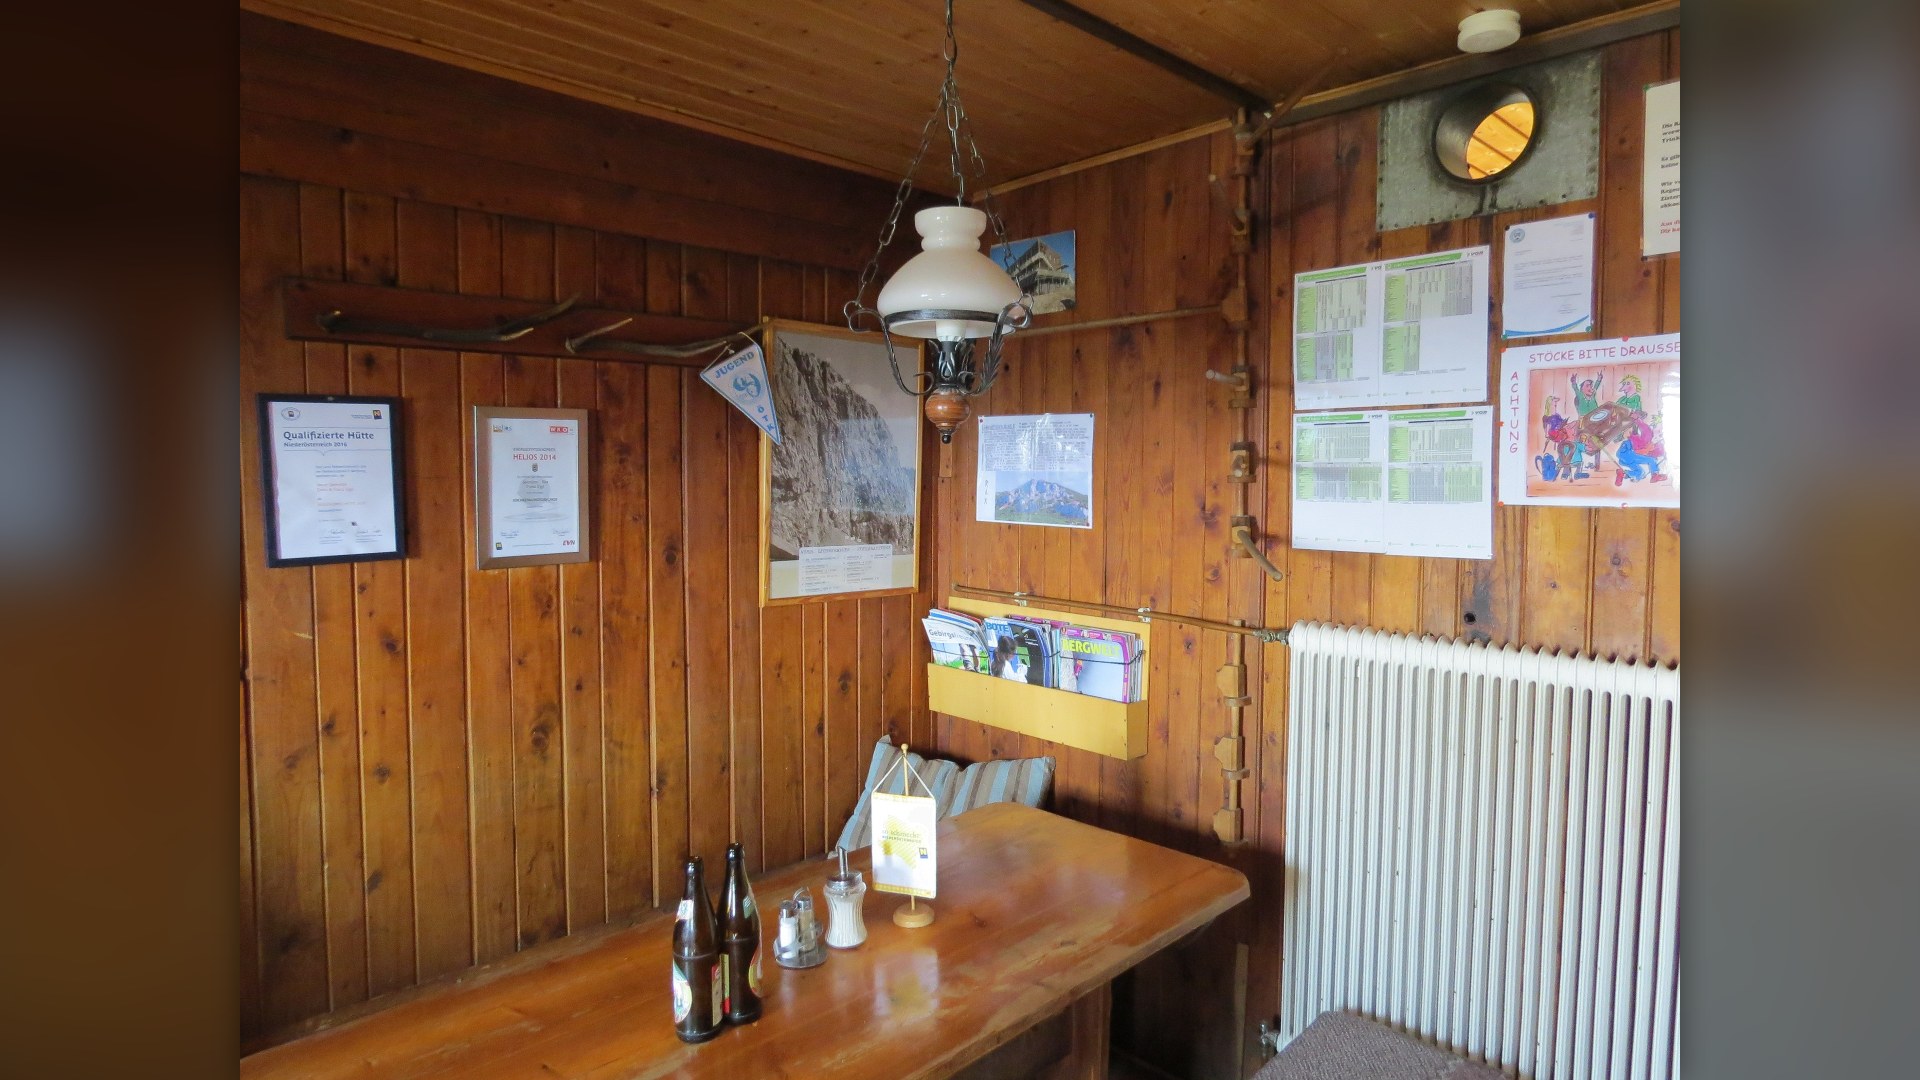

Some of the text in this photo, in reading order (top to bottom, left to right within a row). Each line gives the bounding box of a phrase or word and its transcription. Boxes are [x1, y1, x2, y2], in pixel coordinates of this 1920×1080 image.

[1529, 349, 1574, 363] STÖCKE
[1579, 347, 1616, 359] BITTE
[715, 352, 754, 379] JUGEND
[1509, 371, 1519, 453] ACHTUNG
[284, 431, 374, 441] Qualifizierte Hütte
[986, 622, 1009, 632] BOTE
[1062, 639, 1120, 658] BERGWELT
